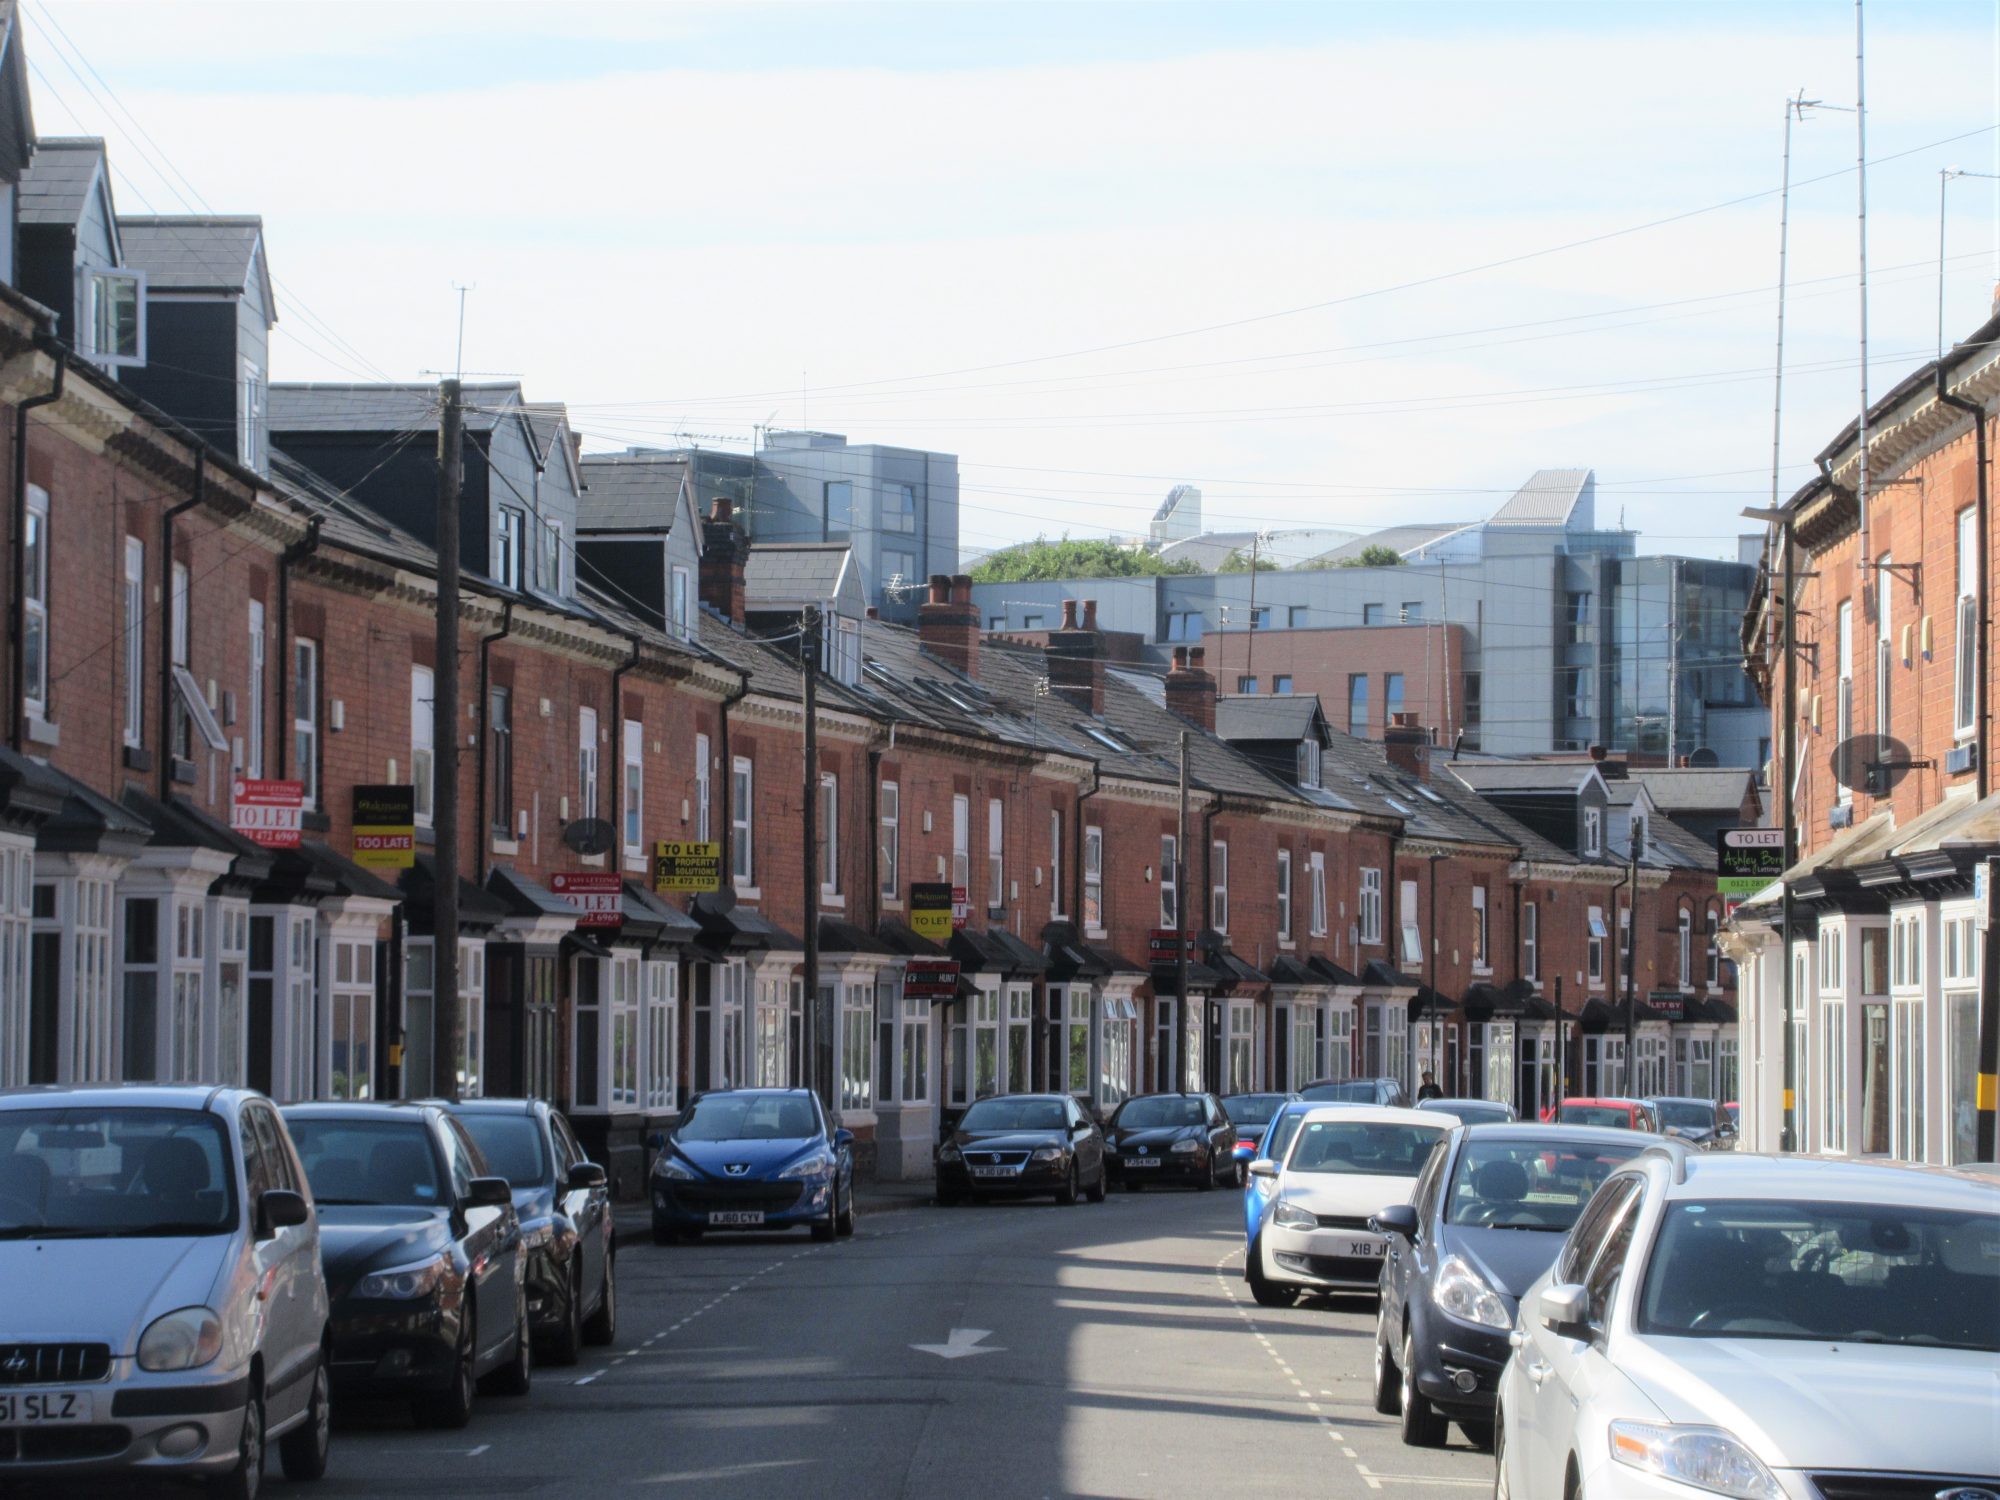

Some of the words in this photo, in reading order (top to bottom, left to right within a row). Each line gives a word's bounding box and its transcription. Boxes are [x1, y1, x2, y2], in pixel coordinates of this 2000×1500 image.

[235, 807, 257, 826] TO
[263, 807, 299, 827] LET
[358, 837, 380, 849] TOO
[383, 837, 409, 848] LATE
[1737, 834, 1754, 844] TO
[1757, 834, 1778, 844] LET
[664, 844, 680, 855] TO
[686, 844, 709, 855] LET
[675, 857, 716, 866] PROPERTY
[1724, 849, 1757, 874] Ashley
[675, 867, 717, 875] SOLUTIONS
[679, 877, 693, 885] 472
[585, 895, 618, 910] LET
[914, 917, 929, 925] TO
[931, 917, 948, 925] LET
[938, 973, 956, 983] HUNT
[740, 1212, 760, 1223] CYV
[24, 1393, 76, 1420] SLZ
